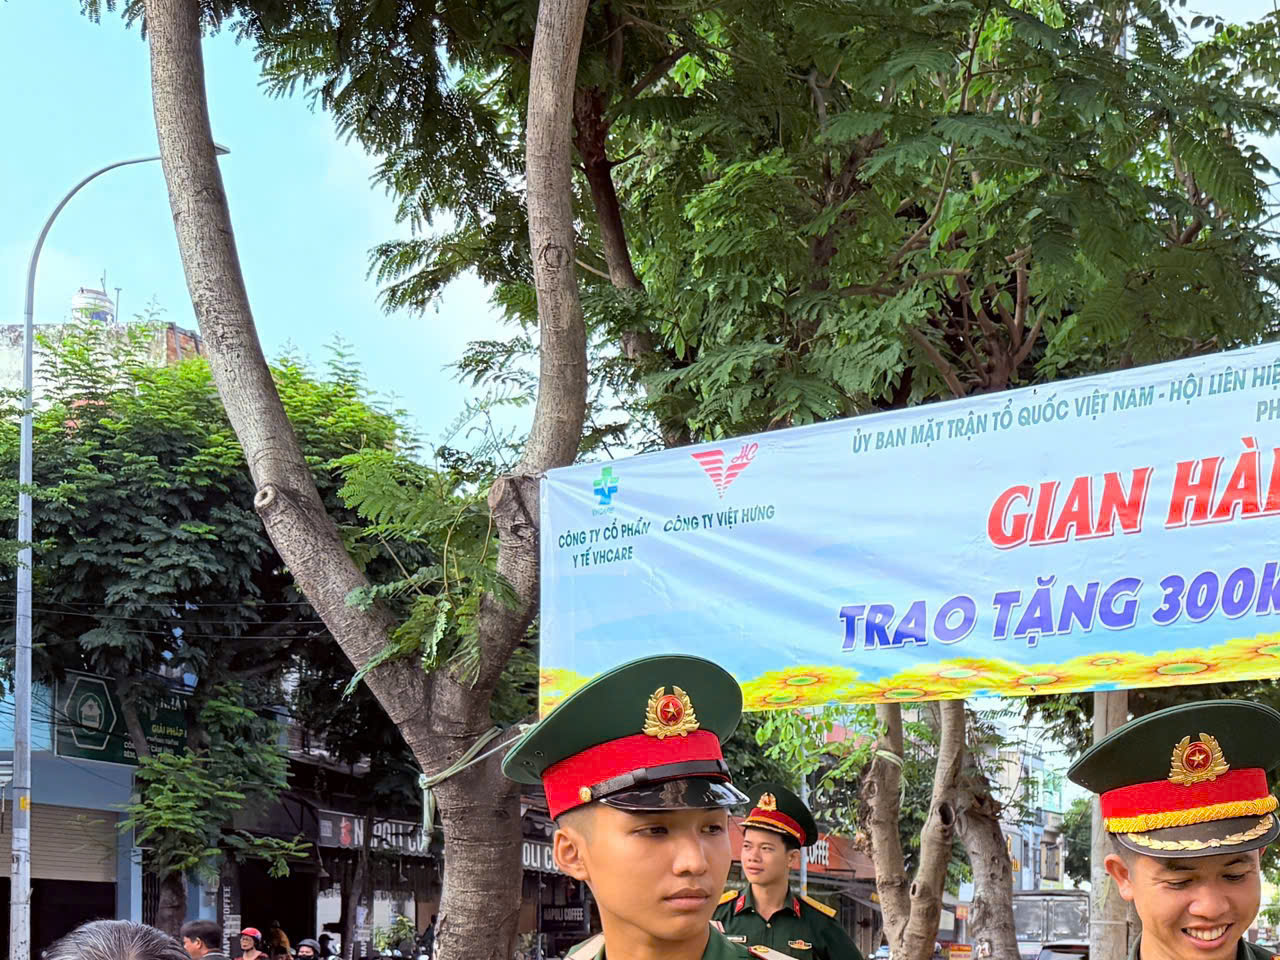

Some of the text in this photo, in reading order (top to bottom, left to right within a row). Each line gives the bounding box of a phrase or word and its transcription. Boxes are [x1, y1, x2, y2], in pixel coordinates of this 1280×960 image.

[852, 428, 873, 454] ỦY
[875, 427, 907, 450] BAN
[910, 418, 945, 448] MẶT
[947, 410, 988, 441] TRẬN
[992, 398, 1014, 431] TỔ
[1018, 393, 1070, 427] QUỐC
[1075, 389, 1110, 421] VIỆT
[1112, 385, 1155, 412] NAM
[1169, 372, 1203, 405] HỘI
[1208, 365, 1247, 395] LIÊN
[558, 516, 652, 549] CÔNG TY CỔ PHẦN
[663, 503, 775, 533] CÔNG TY VIỆT HƯNG
[987, 463, 1152, 551] GIAN
[572, 545, 633, 569] Y TẾ VHCARE
[838, 593, 978, 653] TRAO
[991, 575, 1144, 648] TẶNG
